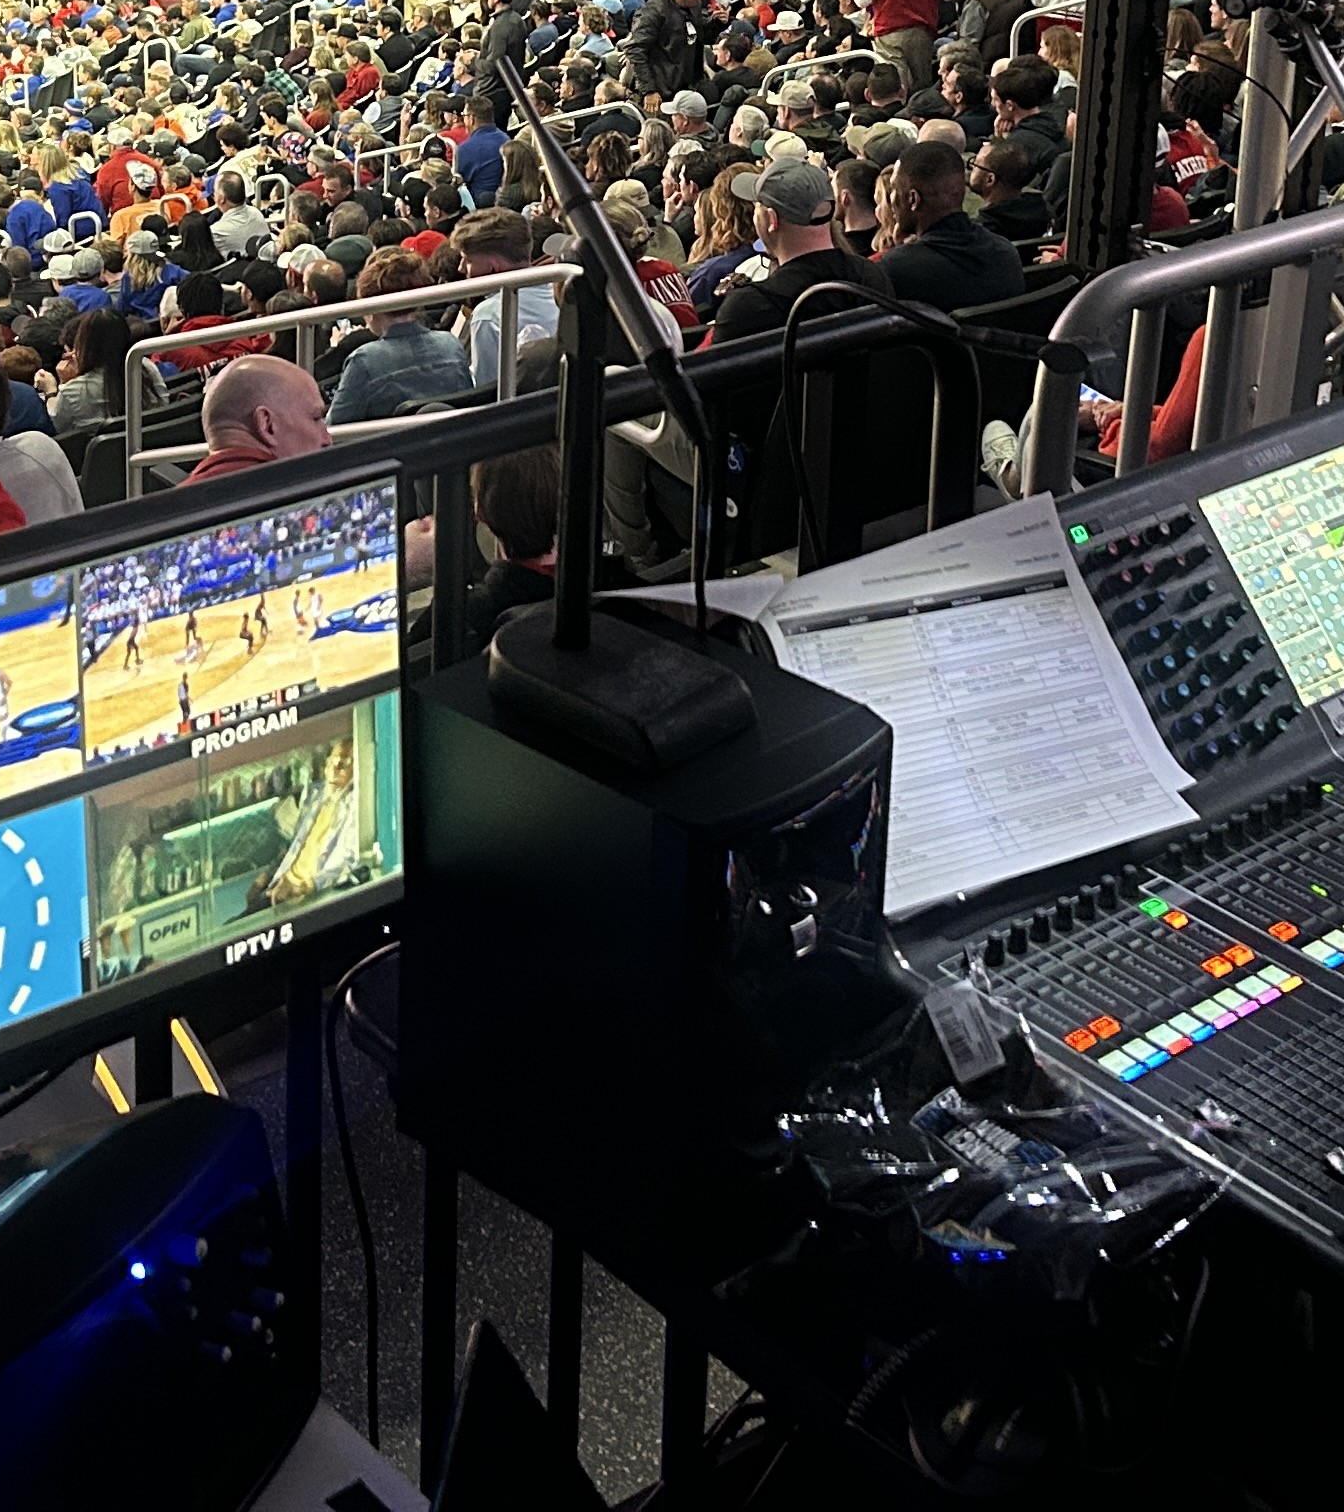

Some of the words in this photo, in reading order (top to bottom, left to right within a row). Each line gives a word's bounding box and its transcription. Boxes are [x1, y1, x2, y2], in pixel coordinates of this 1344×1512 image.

[191, 706, 298, 758] PROGRAM
[149, 917, 191, 942] OPEN
[225, 929, 275, 965] IPTV
[279, 922, 294, 944] 5
